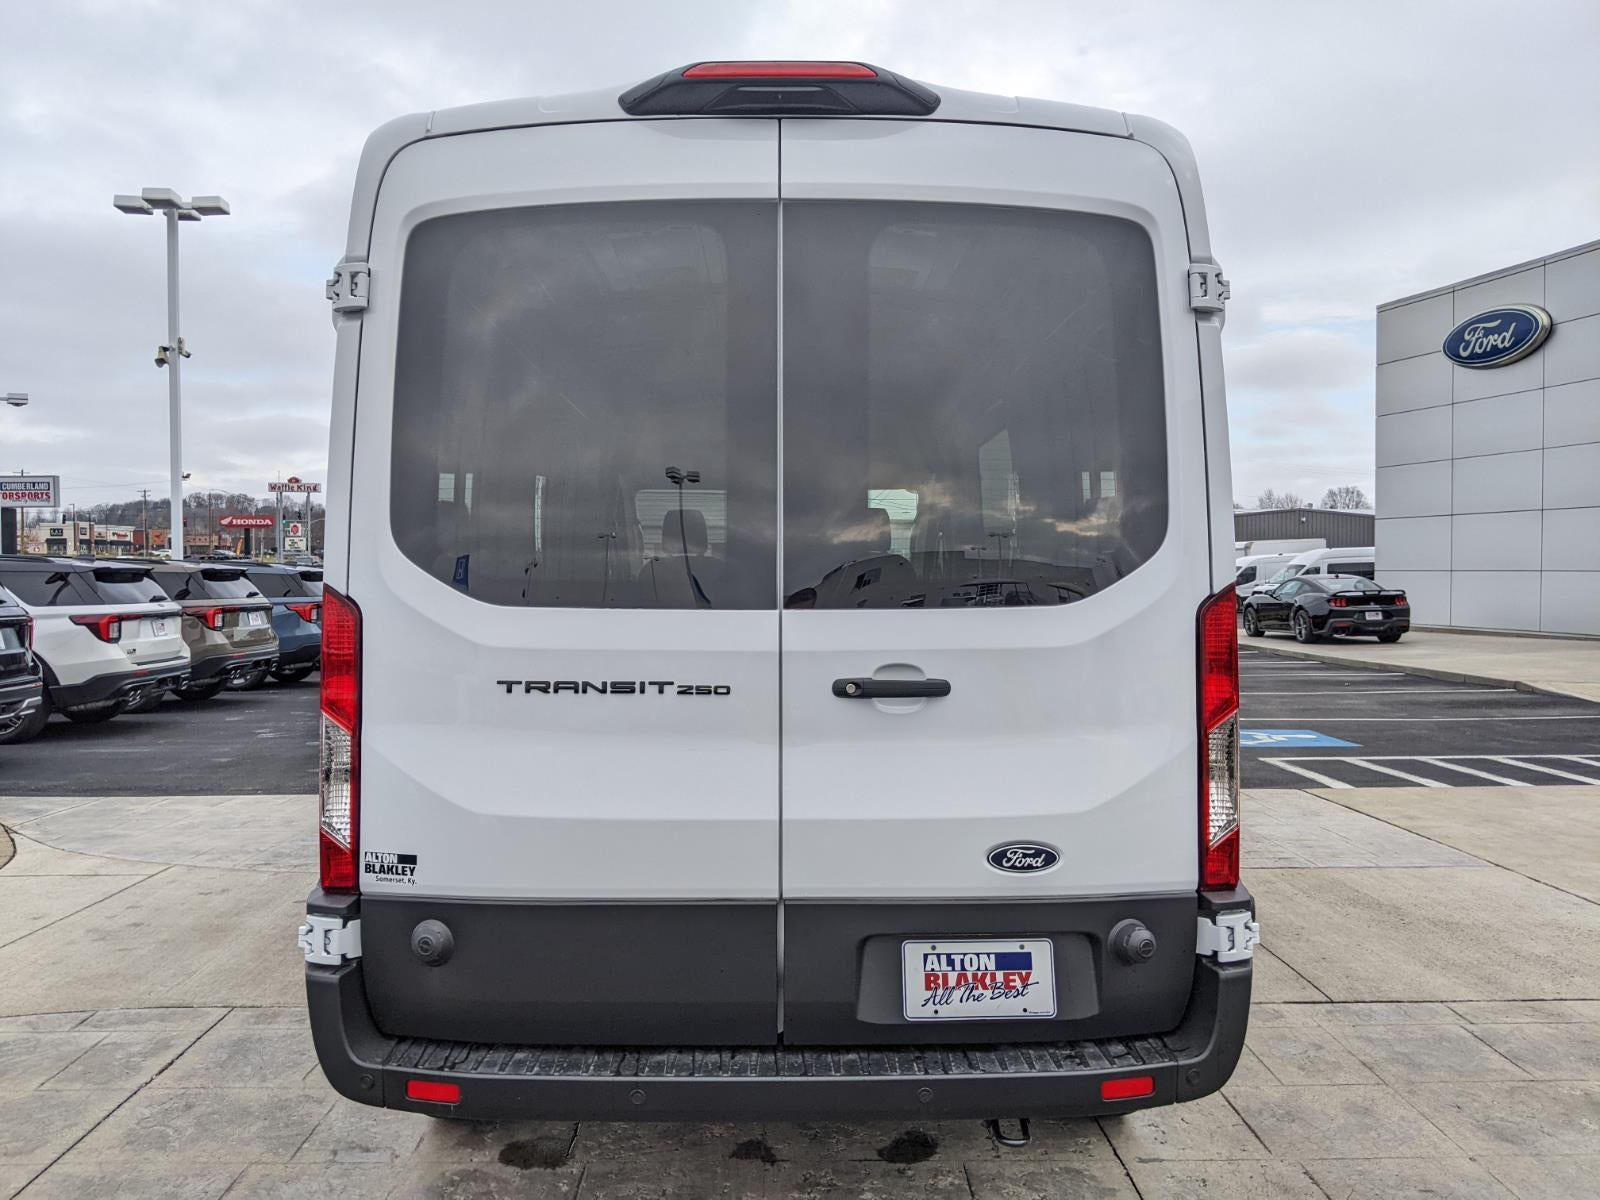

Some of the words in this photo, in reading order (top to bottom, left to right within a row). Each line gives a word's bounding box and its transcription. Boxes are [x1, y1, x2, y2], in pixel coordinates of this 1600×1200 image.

[1459, 319, 1517, 358] Ford
[1, 482, 49, 490] CUMBERLAND
[269, 483, 295, 492] Waffle
[296, 483, 318, 492] King
[0, 491, 51, 500] ORSPORTS
[232, 518, 273, 526] HONDA
[496, 680, 675, 694] TRANSIT
[676, 684, 731, 696] 250
[364, 851, 398, 864] ALTON
[1002, 848, 1046, 868] Ford
[364, 863, 416, 877] BLAKLEY
[924, 953, 996, 972] ALTON
[924, 971, 1032, 992] BLAKLEY
[921, 986, 957, 1008] All
[957, 981, 988, 1004] The
[989, 980, 1040, 1001] Best
